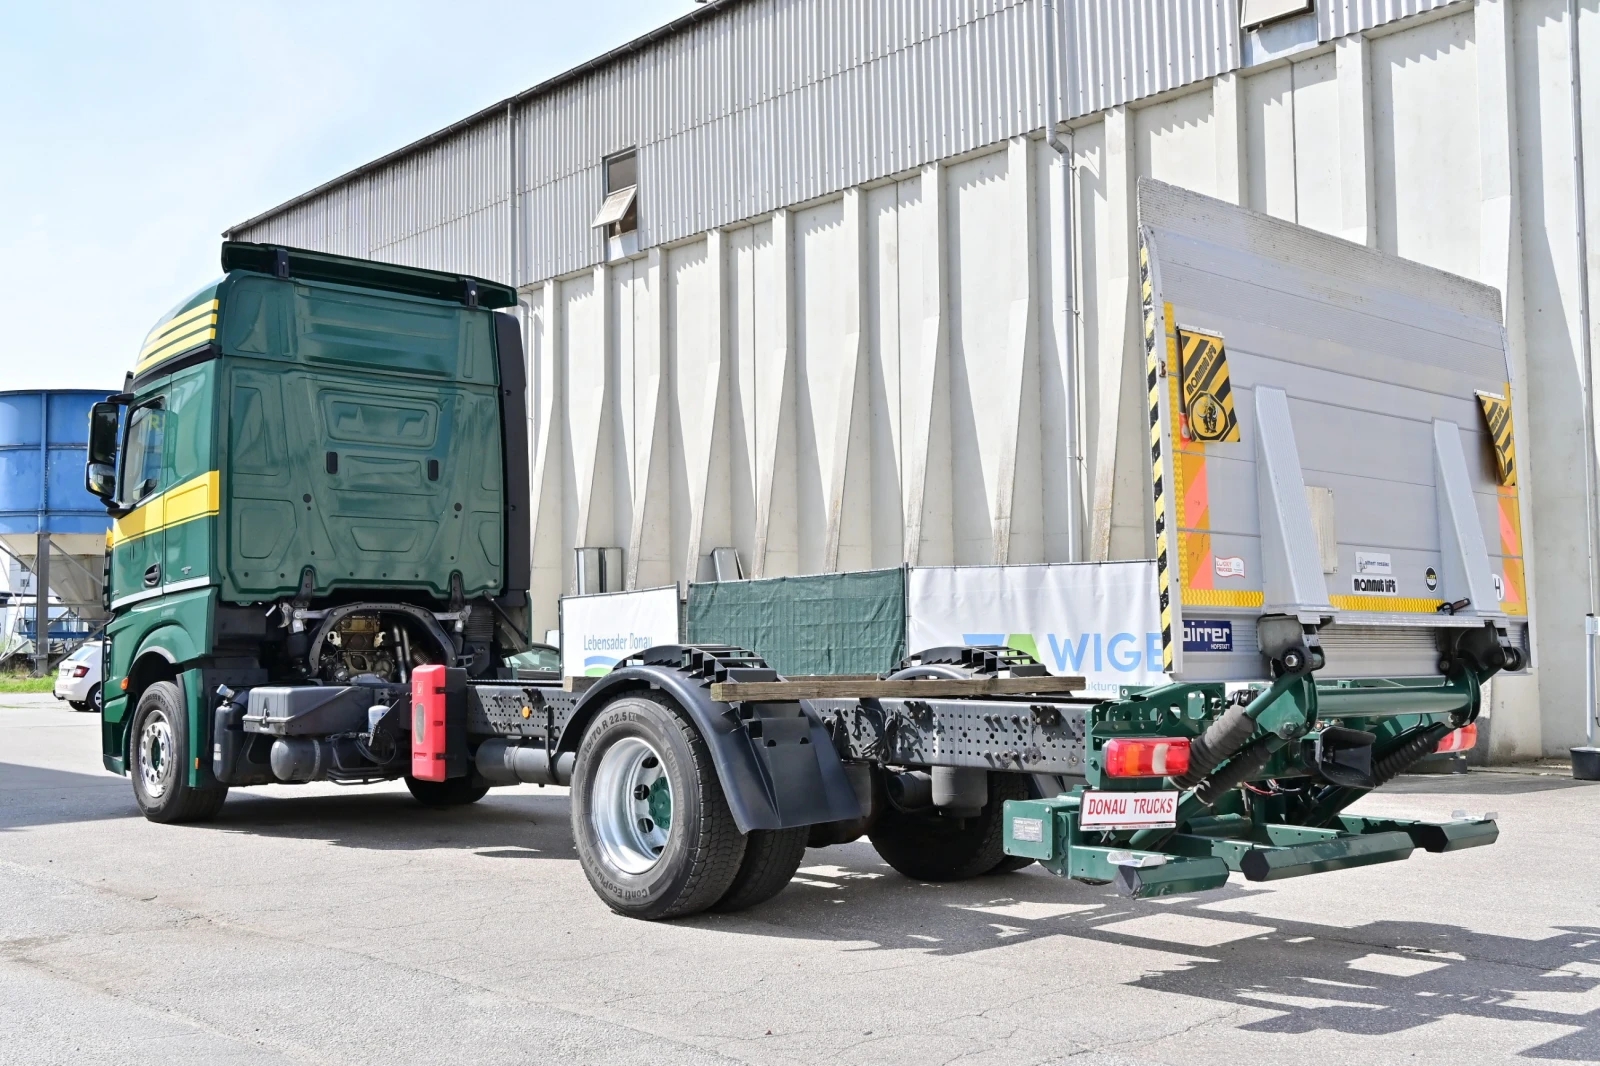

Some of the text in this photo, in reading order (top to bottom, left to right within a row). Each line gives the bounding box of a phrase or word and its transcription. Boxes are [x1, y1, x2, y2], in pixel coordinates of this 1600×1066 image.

[1206, 344, 1217, 362] lift
[1494, 577, 1502, 600] H
[584, 632, 653, 651] Lebensader Donau
[1047, 632, 1164, 673] WIGE
[602, 720, 609, 730] R
[609, 711, 627, 725] 22.5
[1088, 797, 1174, 815] DONAU TRUCKS
[594, 866, 623, 899] EcoPlus
[625, 888, 648, 900] Conti
